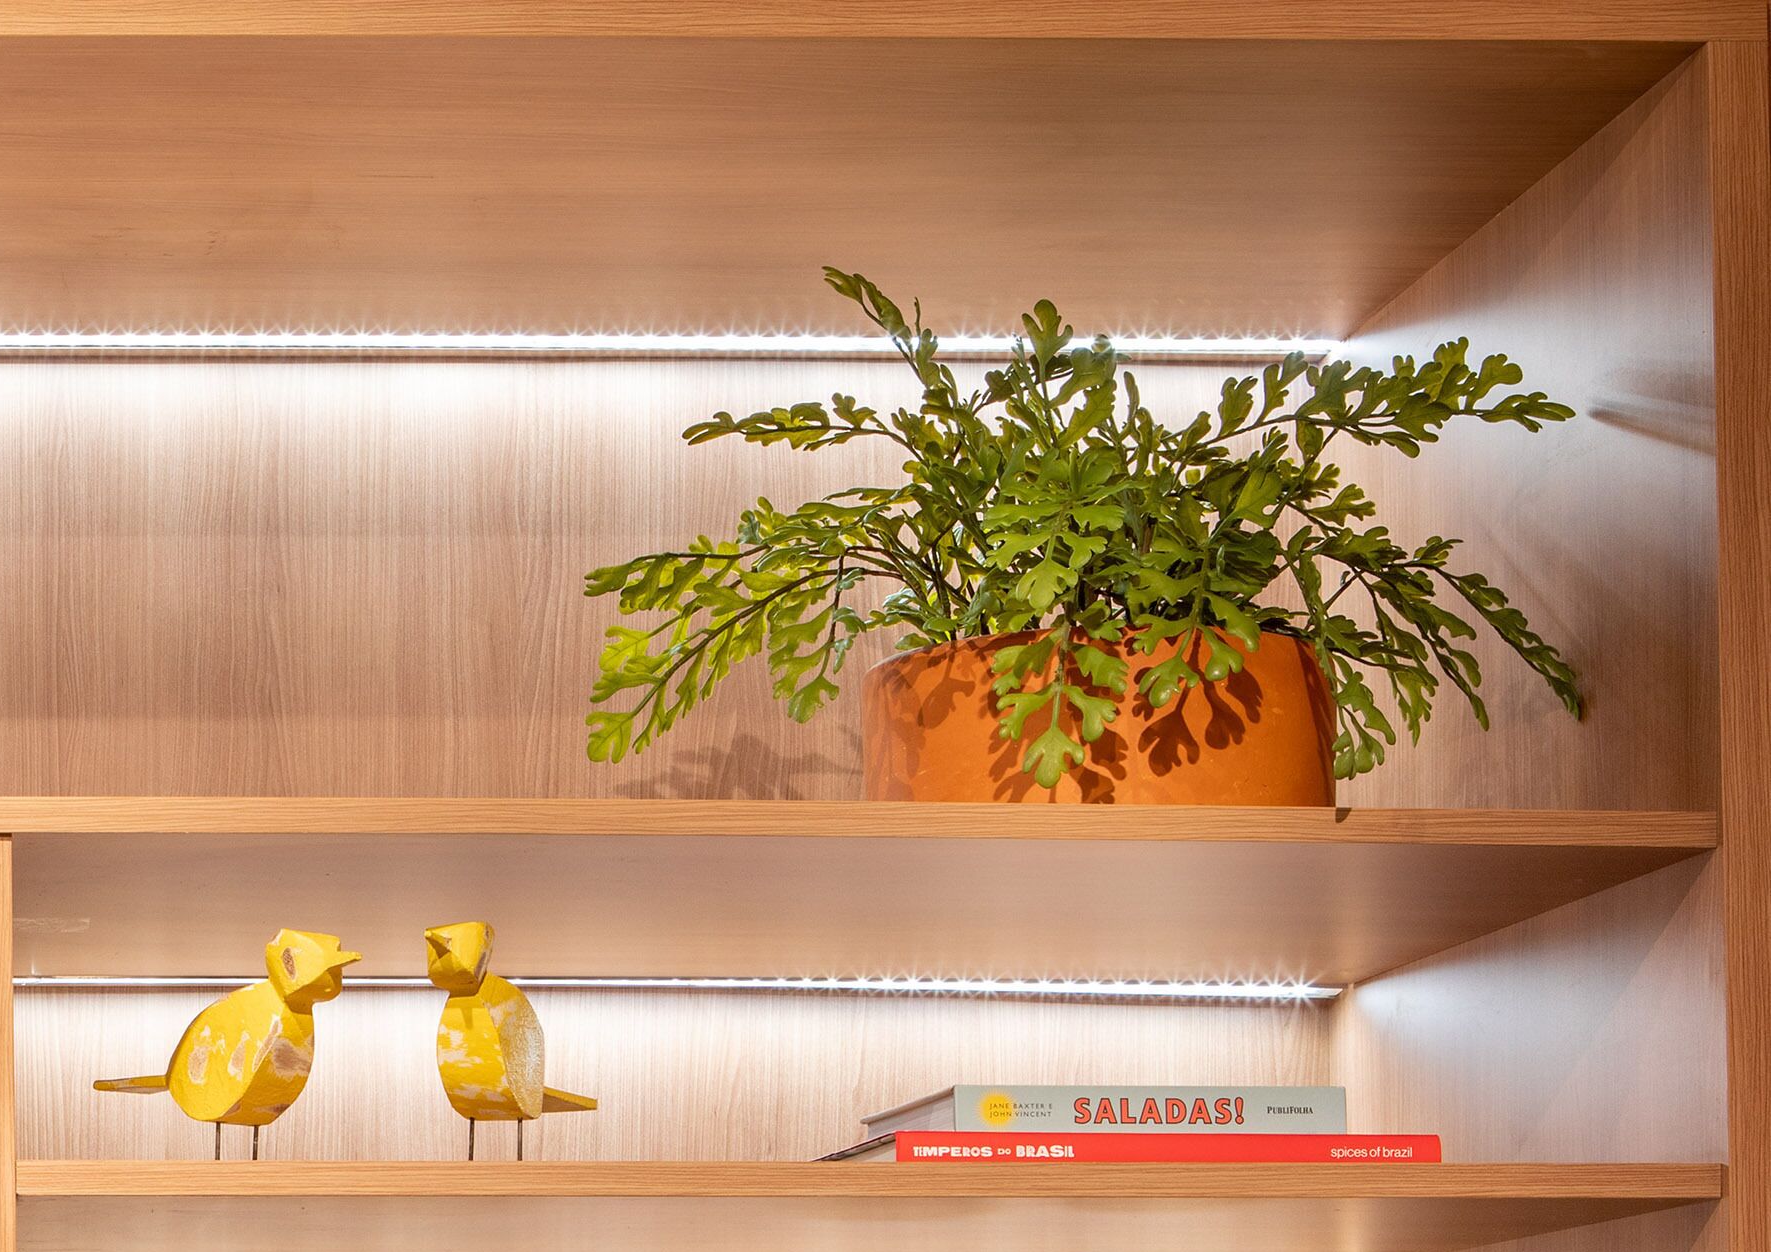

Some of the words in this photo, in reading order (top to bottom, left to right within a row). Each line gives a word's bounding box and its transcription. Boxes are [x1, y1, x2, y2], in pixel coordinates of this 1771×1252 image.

[1073, 1096, 1245, 1125] SALADAS!
[1330, 1146, 1368, 1159] spices
[1369, 1147, 1381, 1158] of
[1382, 1146, 1413, 1158] brazil
